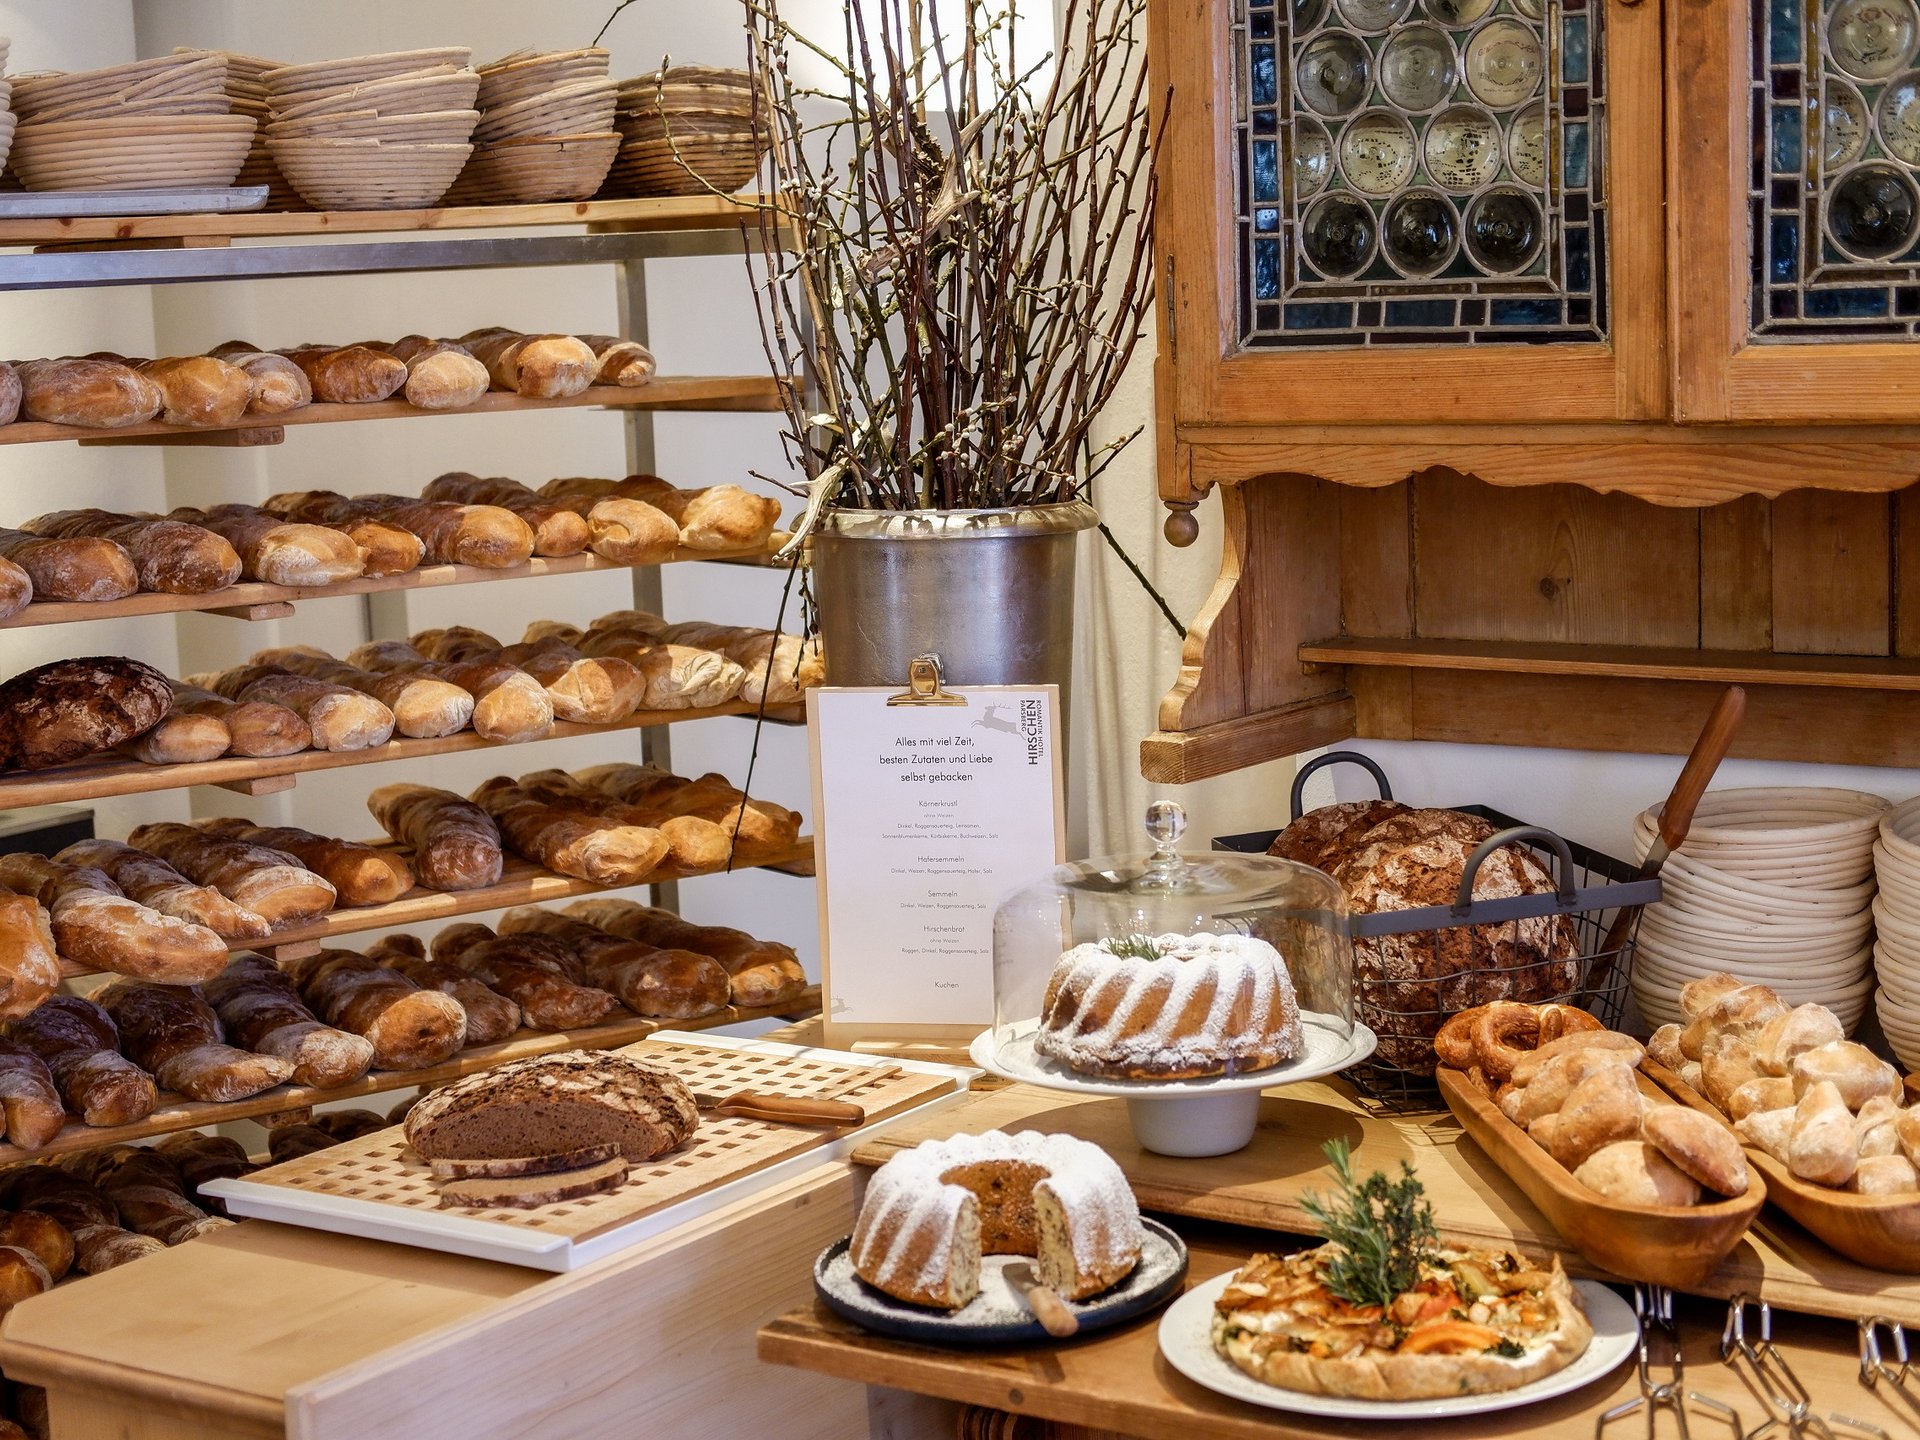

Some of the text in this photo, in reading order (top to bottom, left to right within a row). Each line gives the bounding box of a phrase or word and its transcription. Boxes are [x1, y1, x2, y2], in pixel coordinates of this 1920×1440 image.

[1026, 700, 1038, 765] HIRSCHEN
[895, 736, 975, 748] Alles mit viel Zeit,
[879, 754, 993, 765] besten Zutaten und Liebe
[901, 772, 973, 783] selbst gebacken
[928, 890, 958, 898] Semmeln
[924, 925, 965, 933] Hirschenbrot
